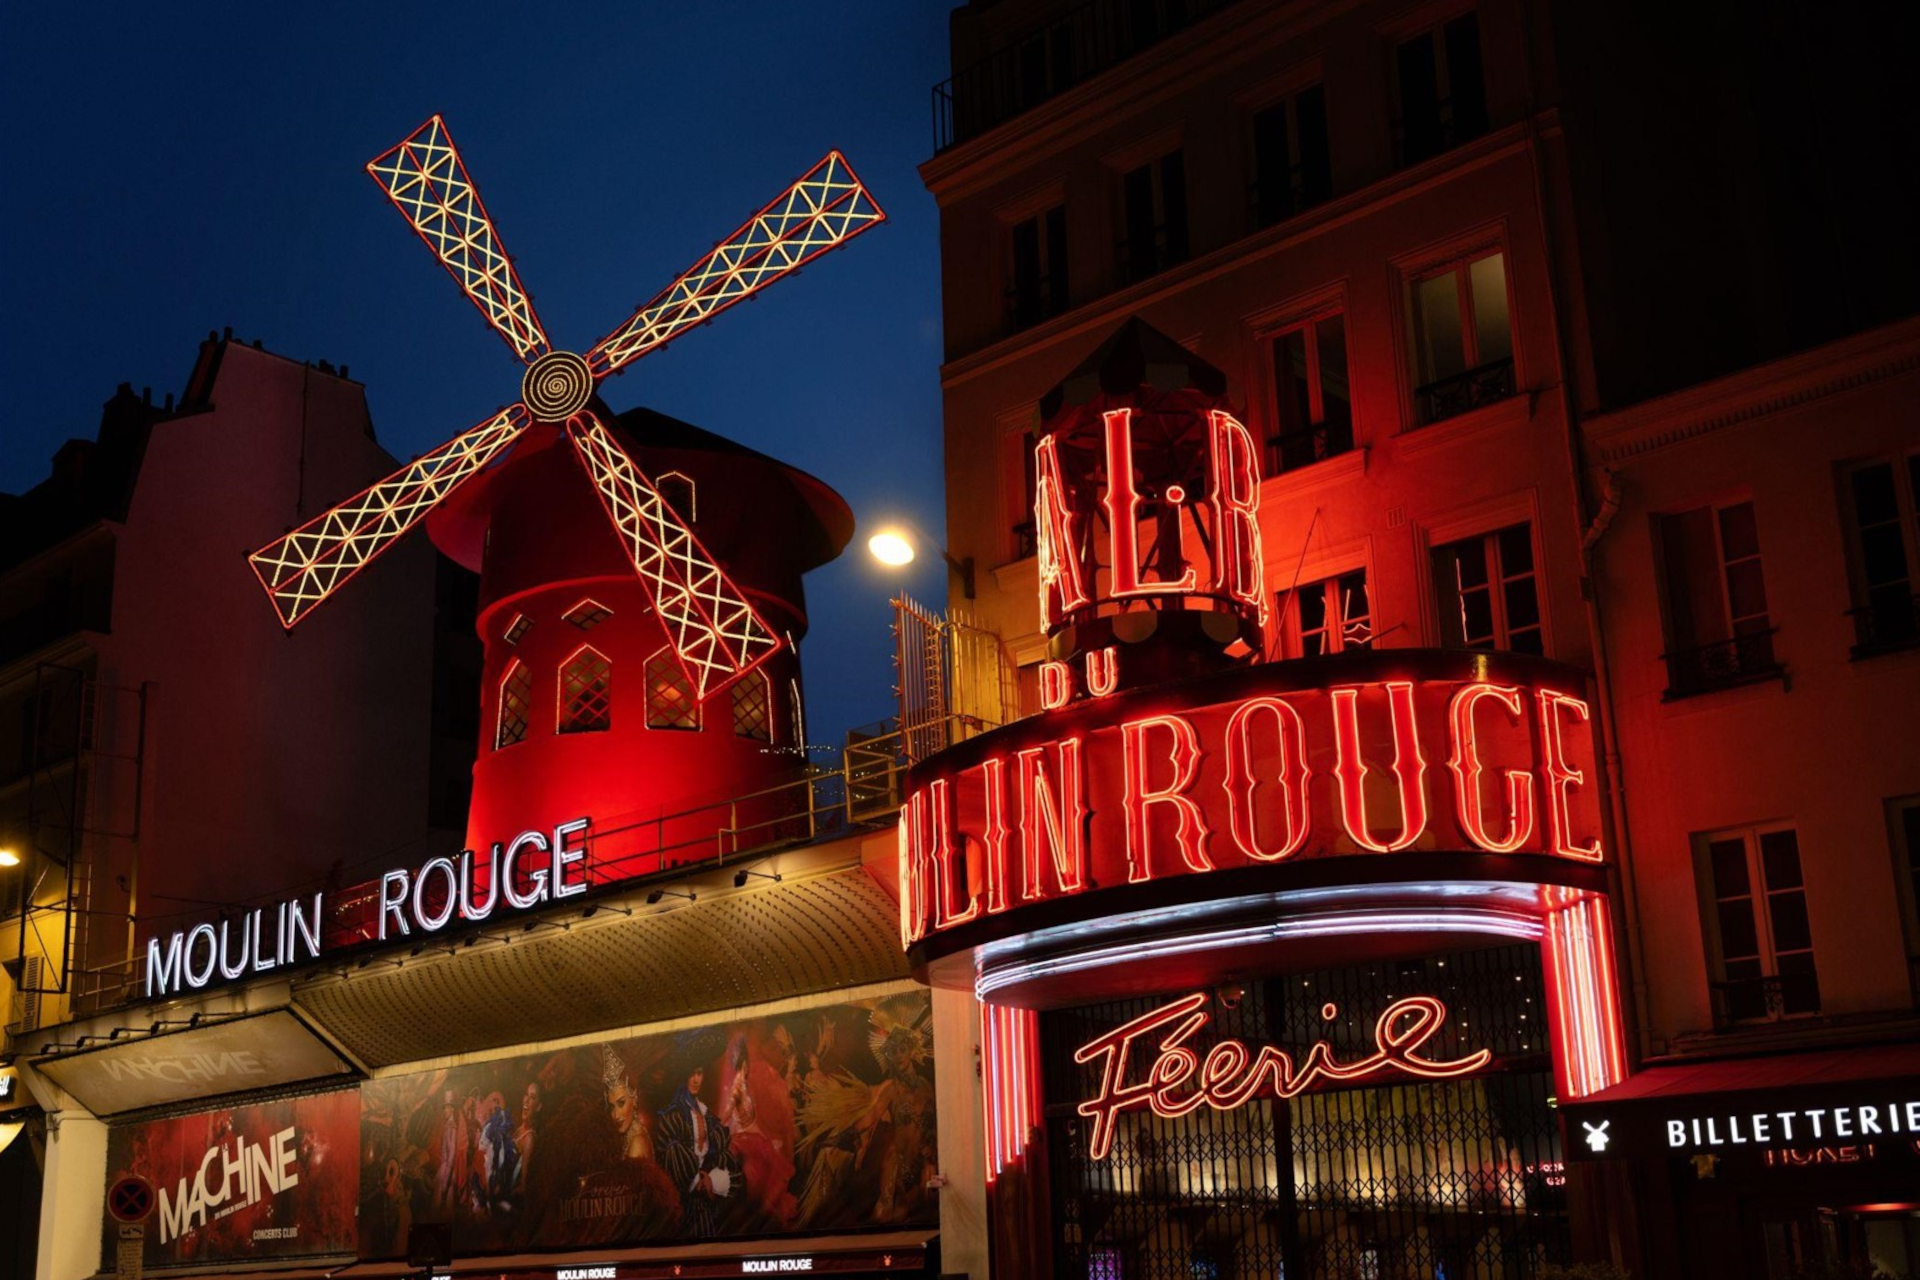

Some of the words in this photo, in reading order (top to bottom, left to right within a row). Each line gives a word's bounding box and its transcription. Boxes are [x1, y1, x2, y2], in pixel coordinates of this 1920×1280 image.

[1039, 645, 1118, 710] DU
[898, 737, 1082, 951] ULIN
[1120, 681, 1603, 884] ROUGE
[145, 892, 323, 997] MOULIN
[378, 816, 589, 941] ROUGE
[1074, 992, 1491, 1160] Féerie
[1666, 1101, 1920, 1147] BILLETTERIE
[158, 1126, 299, 1245] MACHINE
[252, 1228, 282, 1241] CONCERTS
[282, 1226, 298, 1239] CLUB
[742, 1260, 778, 1273] MOULIN
[779, 1258, 813, 1271] ROUGE
[557, 1269, 587, 1280] MOULIN
[588, 1267, 616, 1279] ROUGE
